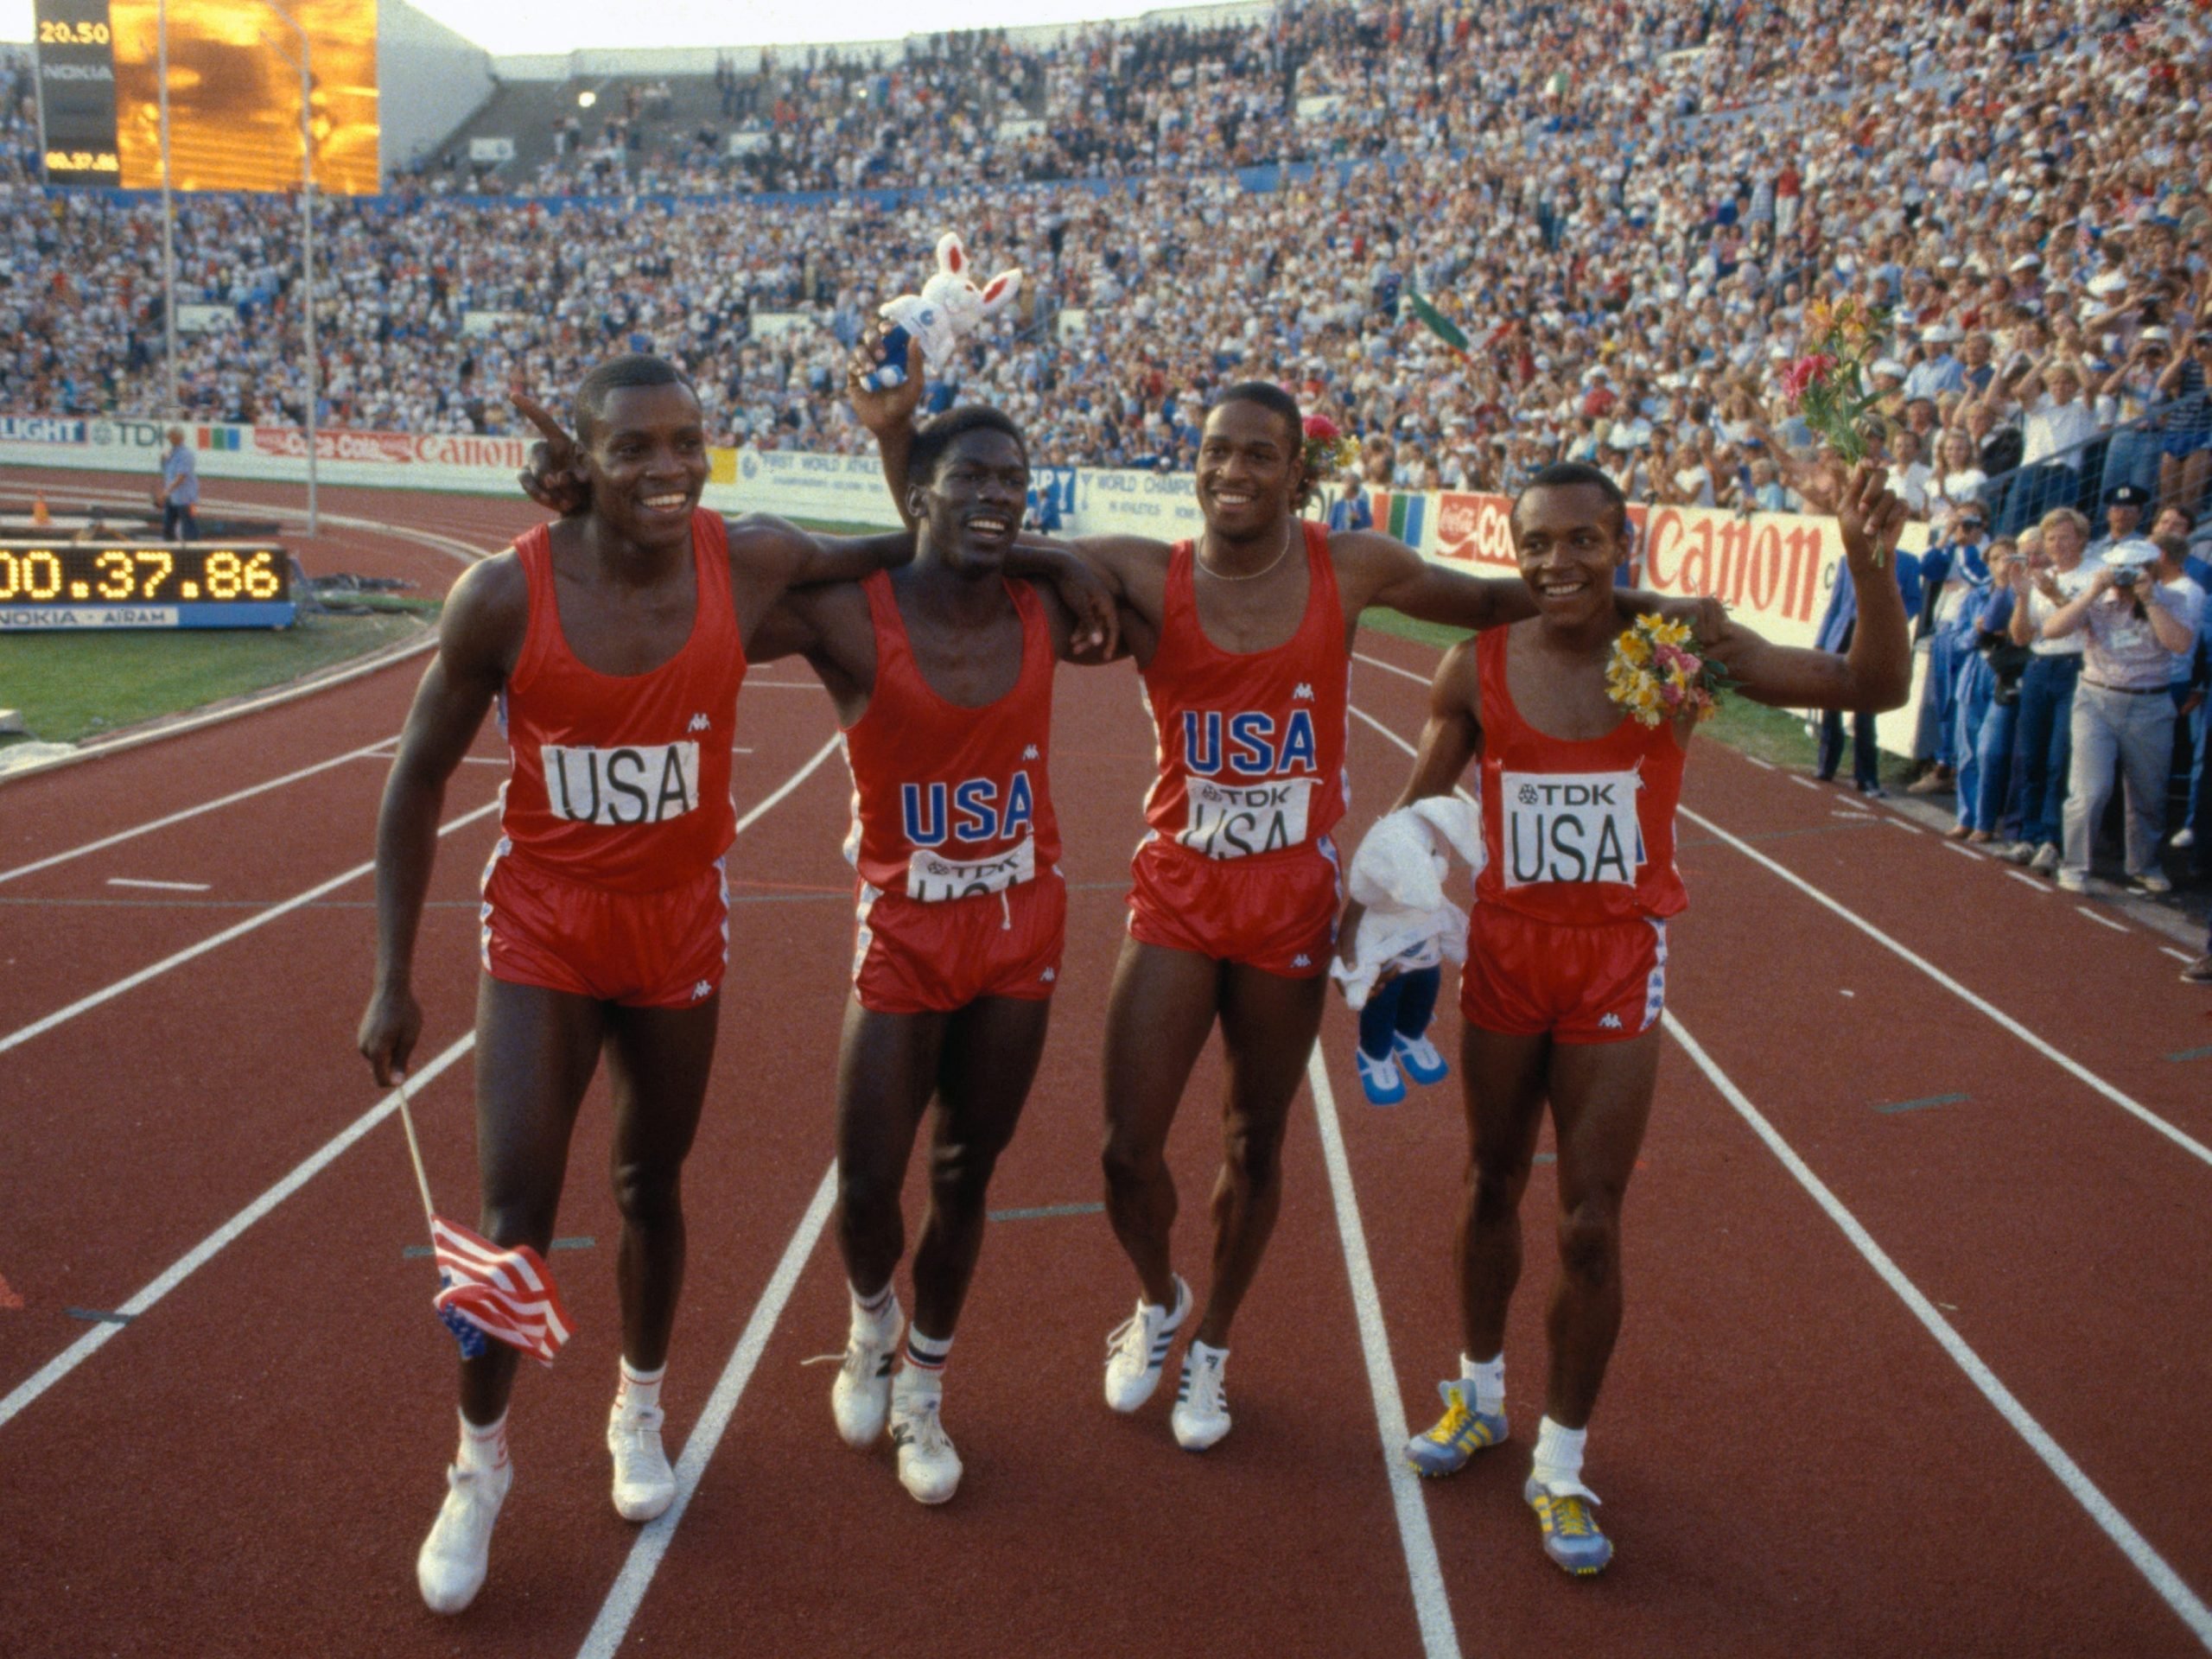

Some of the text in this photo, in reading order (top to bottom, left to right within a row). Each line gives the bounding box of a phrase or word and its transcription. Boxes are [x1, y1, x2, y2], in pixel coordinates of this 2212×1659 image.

[40, 21, 110, 44] 20.50
[42, 64, 114, 81] NOKIA
[416, 435, 524, 467] Canon
[1097, 474, 1137, 493] WORLD
[1648, 508, 1822, 622] Canon
[1182, 709, 1318, 776] USA
[556, 745, 690, 824] USA
[1218, 785, 1291, 808] TDK
[1537, 784, 1616, 806] TDK
[900, 770, 1034, 847] USA
[1511, 811, 1629, 882] USA
